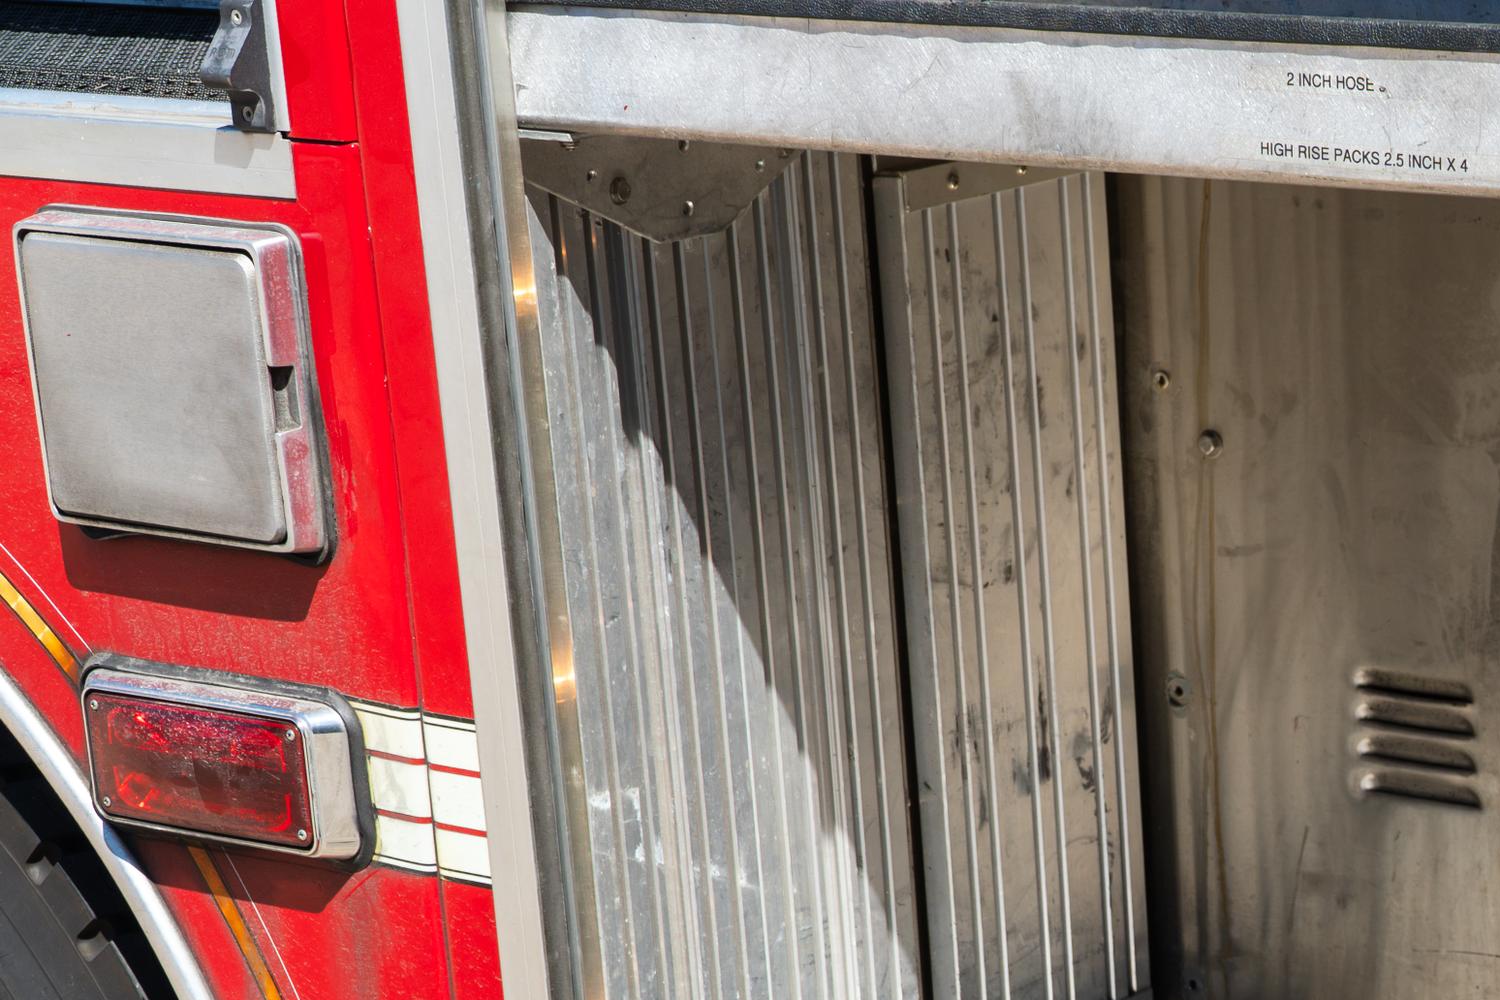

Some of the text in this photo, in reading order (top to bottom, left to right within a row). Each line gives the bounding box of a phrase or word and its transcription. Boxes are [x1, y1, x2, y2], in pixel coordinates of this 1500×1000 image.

[1286, 72, 1375, 92] 2 INCH HOSE
[1260, 142, 1468, 173] HIGH RISE PACKS 2.5 INCH X 4
